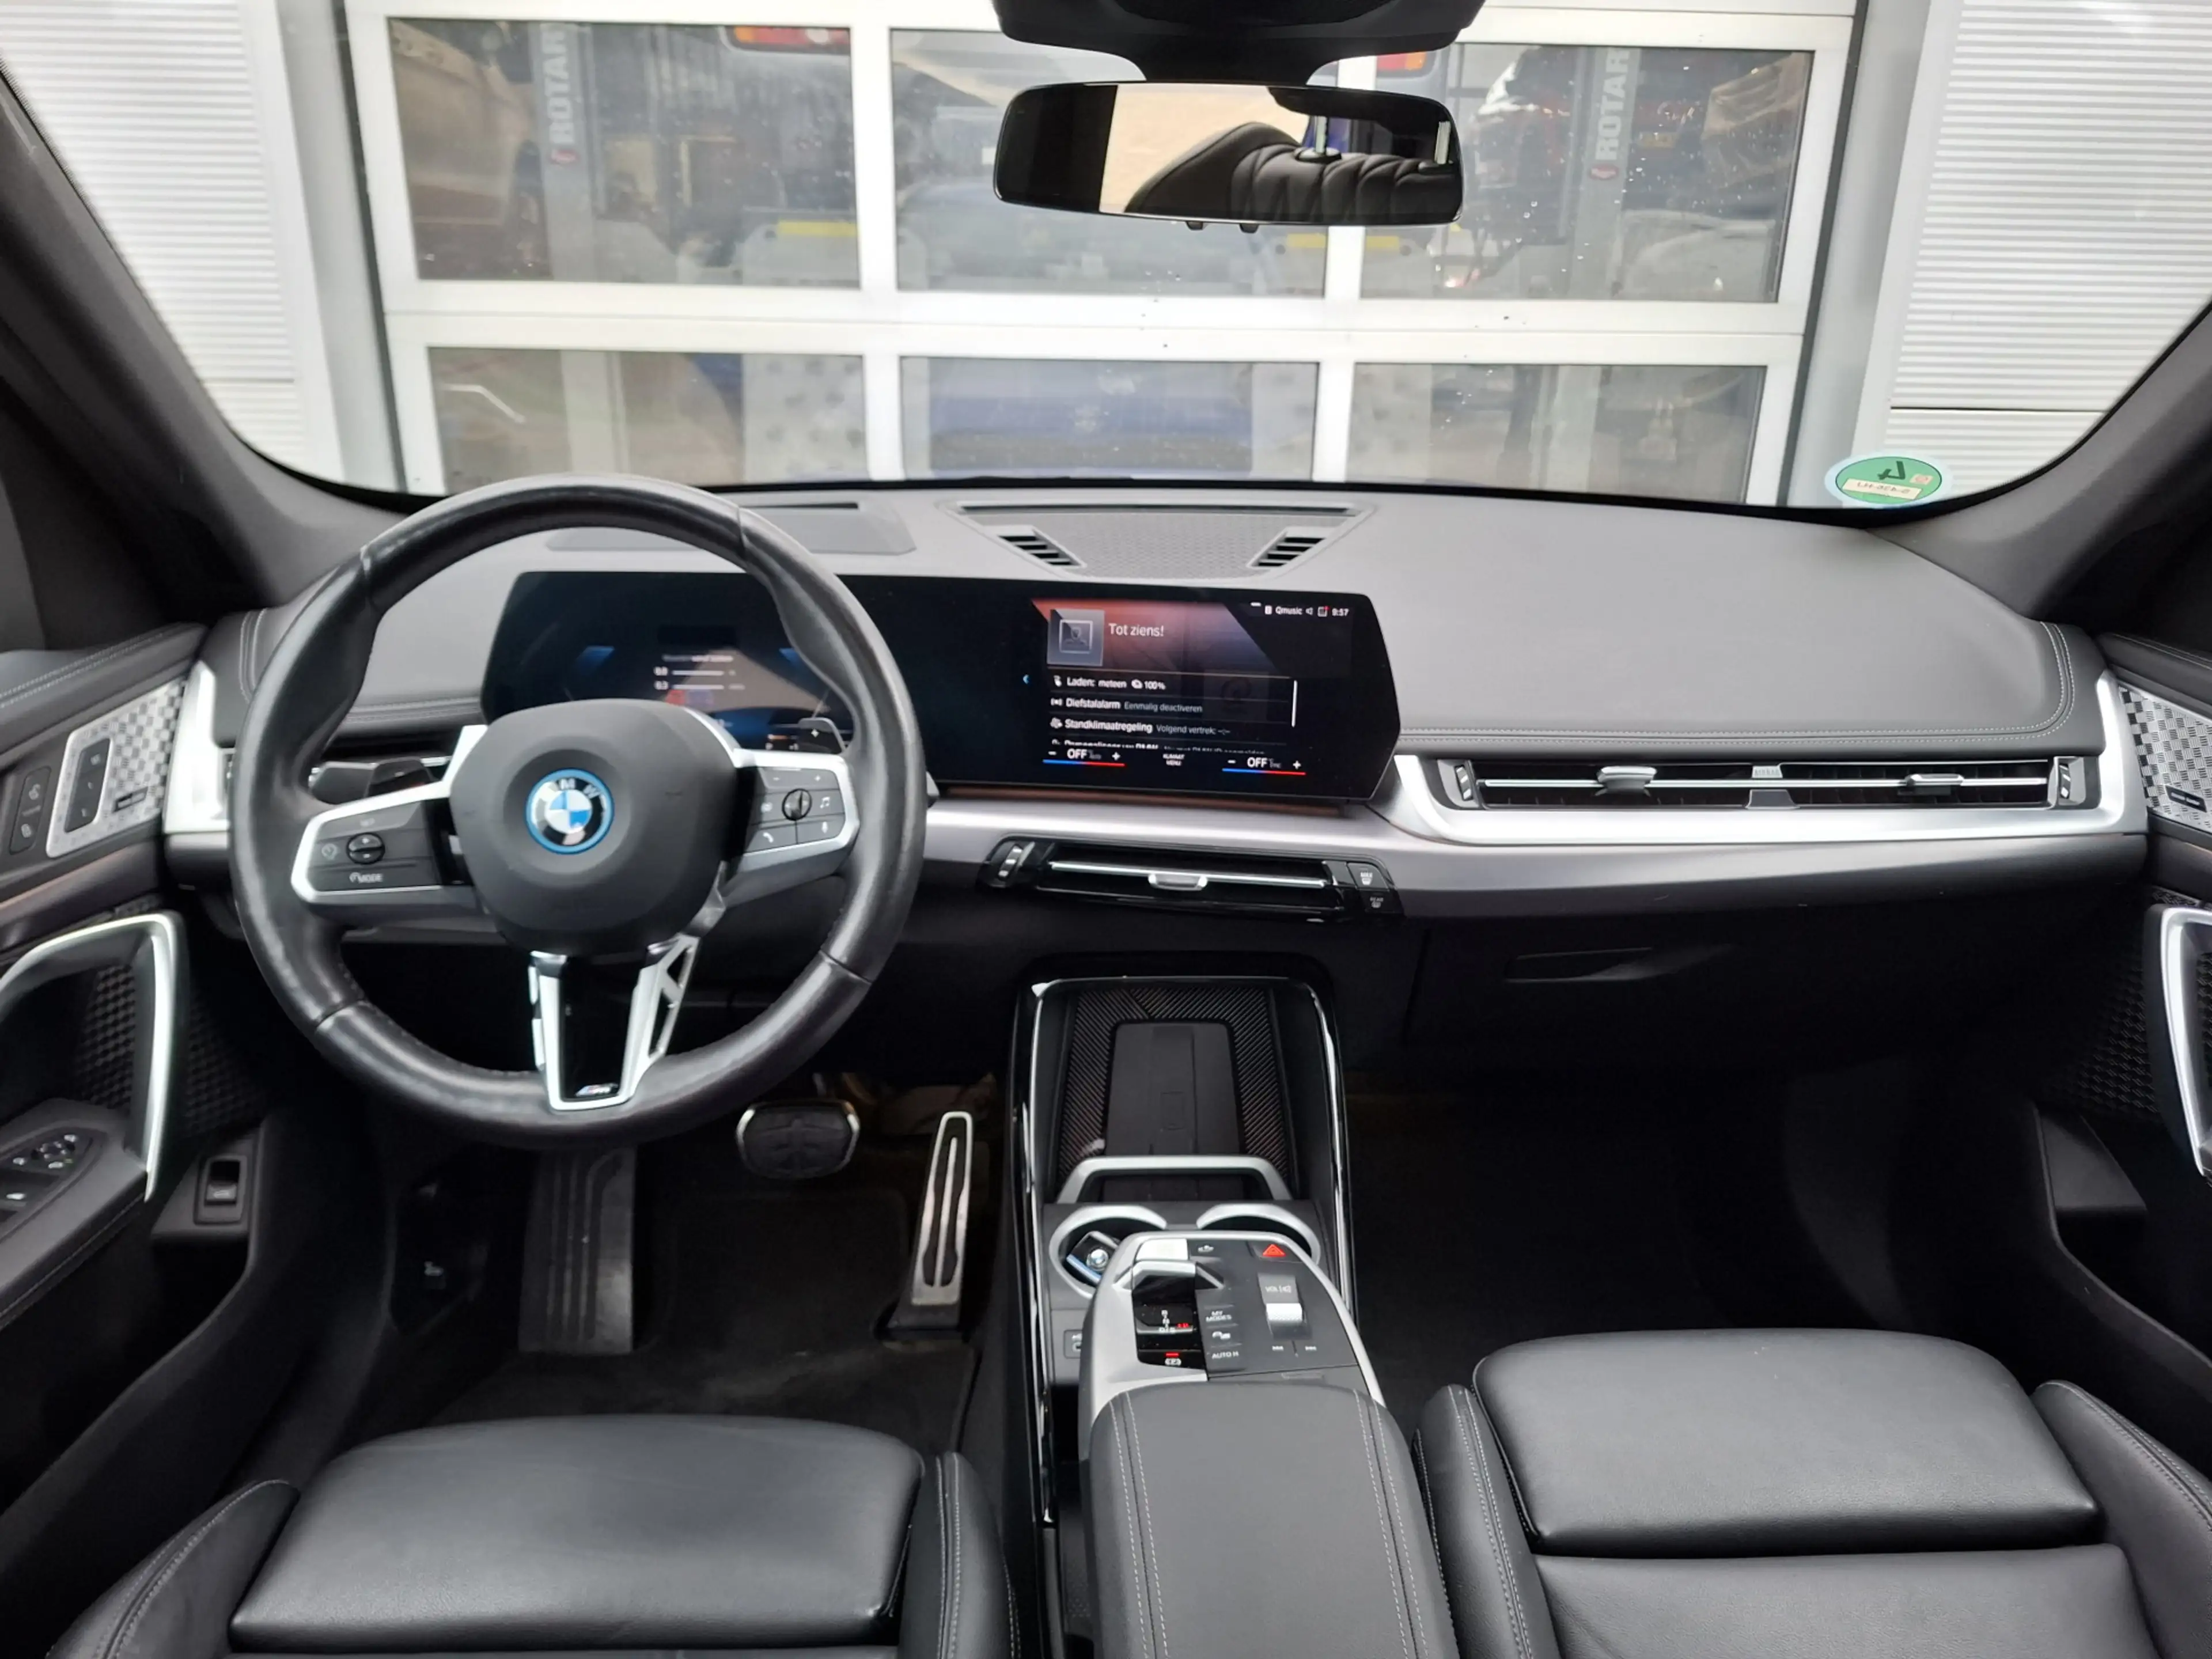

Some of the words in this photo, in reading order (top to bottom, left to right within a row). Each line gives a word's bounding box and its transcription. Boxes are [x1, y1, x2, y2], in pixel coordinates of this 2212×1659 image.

[1275, 606, 1302, 615] Qmusic
[1108, 623, 1128, 636] Tot
[1130, 624, 1164, 637] ziens!
[1067, 677, 1096, 687] Laden:
[1098, 680, 1127, 688] meteen
[1145, 680, 1166, 690] 100%
[1066, 697, 1121, 710] Diefstalalarm
[1124, 701, 1158, 713] Eenmalig
[1160, 702, 1203, 713] deactiveren
[1065, 719, 1153, 734] Standklimaatregeling
[1156, 724, 1187, 734] Volgend
[1067, 748, 1088, 759] OFF
[1247, 757, 1268, 768] OFF
[541, 778, 601, 799] MW
